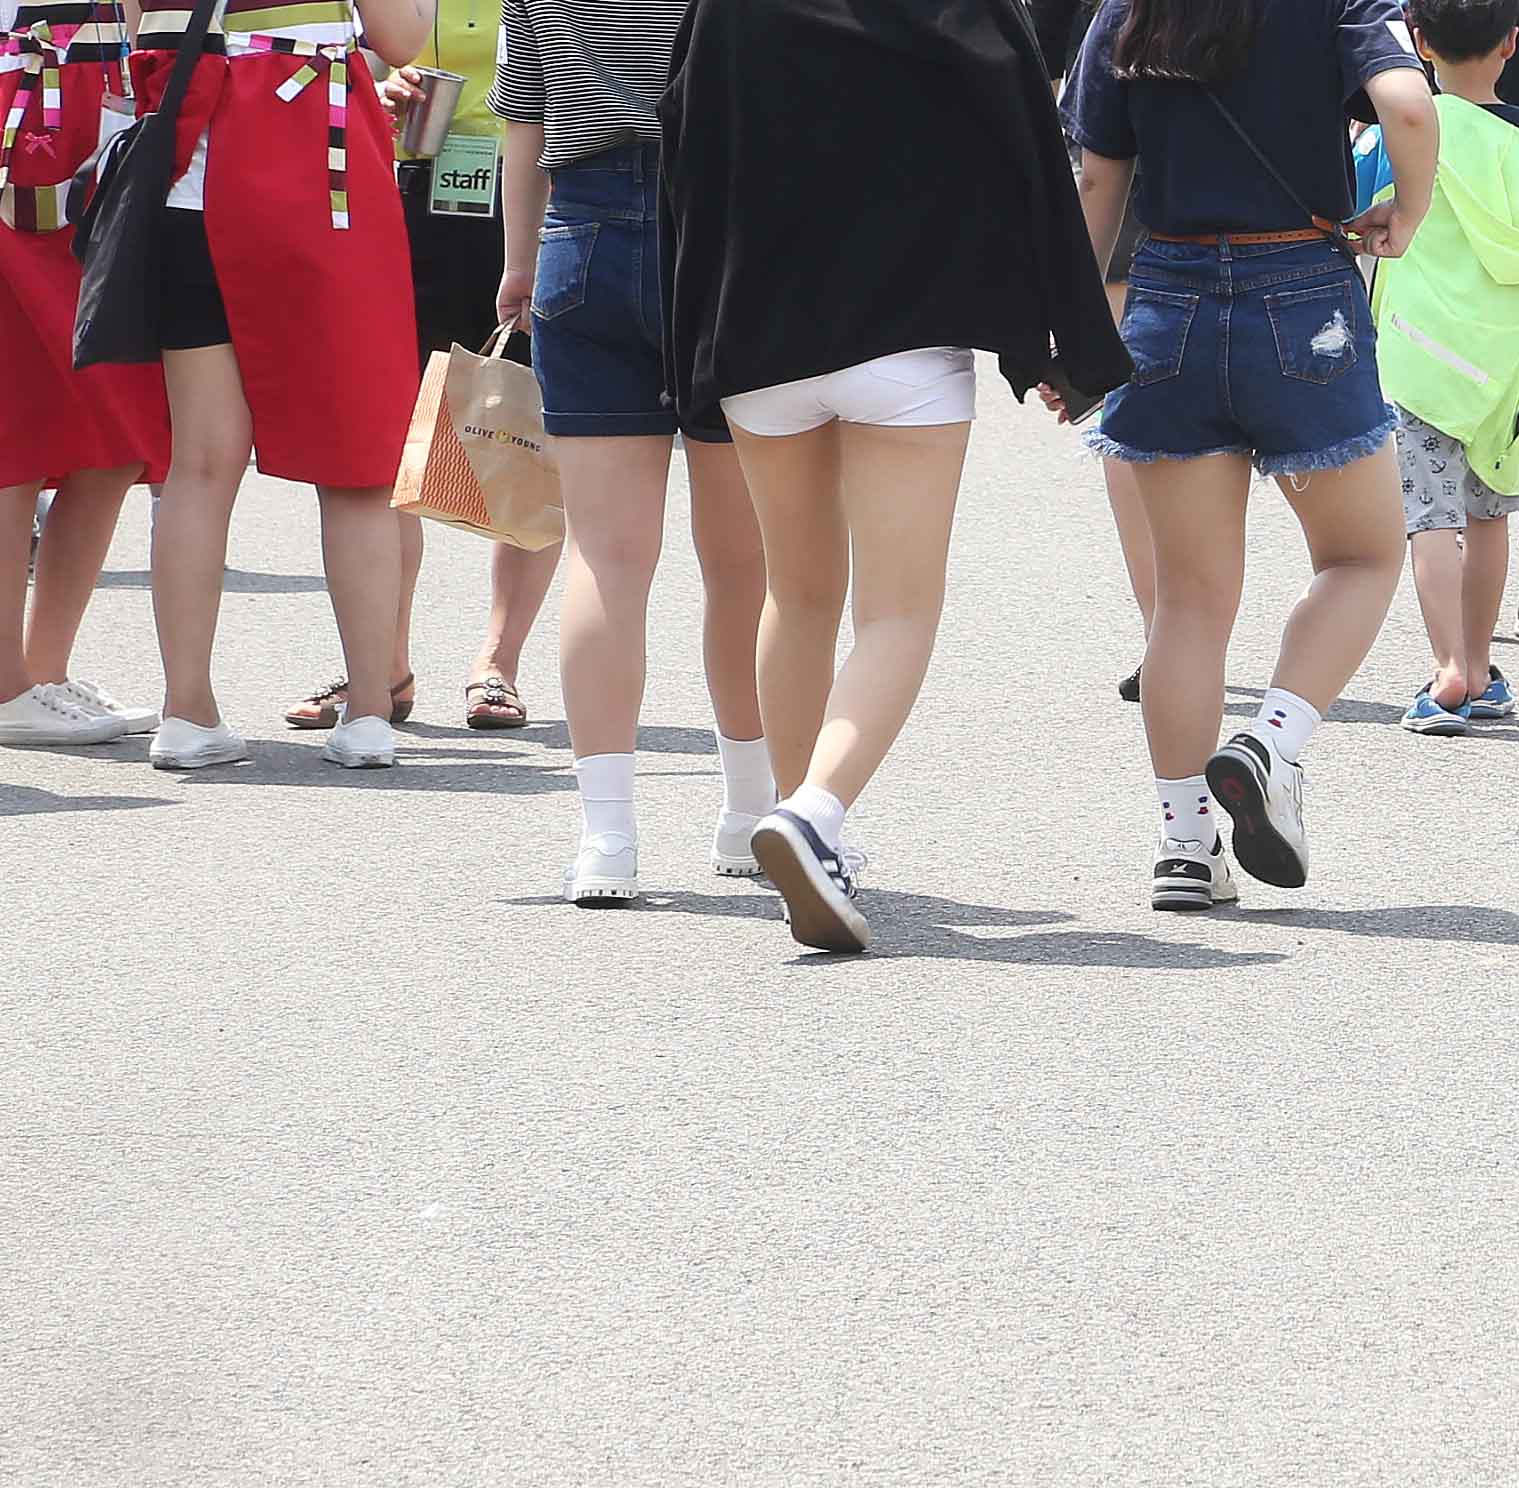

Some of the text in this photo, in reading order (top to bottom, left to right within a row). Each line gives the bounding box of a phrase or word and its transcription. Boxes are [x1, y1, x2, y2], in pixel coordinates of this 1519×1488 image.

[439, 168, 491, 191] staff
[464, 424, 541, 453] OLIVE YOUNG
